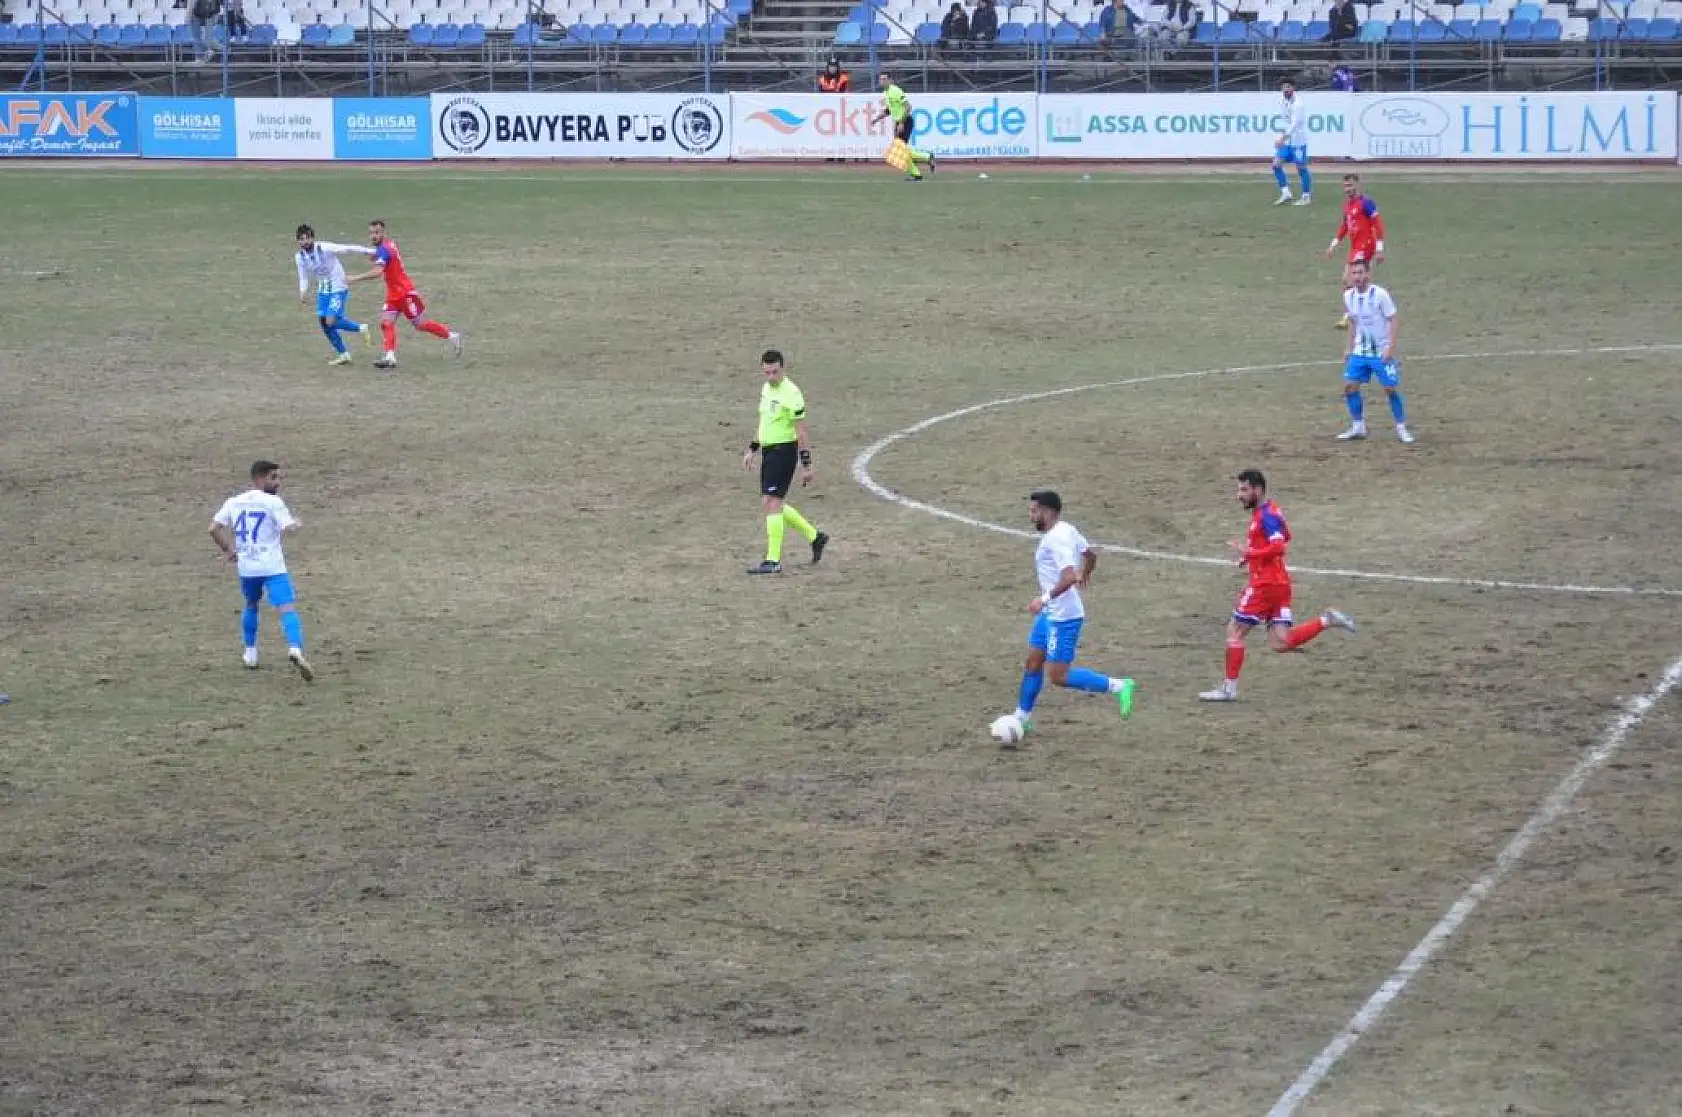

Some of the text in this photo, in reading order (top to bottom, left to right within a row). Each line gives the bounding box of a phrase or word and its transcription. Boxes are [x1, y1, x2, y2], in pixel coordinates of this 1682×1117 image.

[0, 100, 120, 136] FAK
[495, 115, 610, 142] BAVYERA
[1087, 114, 1345, 134] ASSA CONSTRUCON
[1460, 96, 1659, 154] HİLMİ
[233, 510, 266, 544] 47
